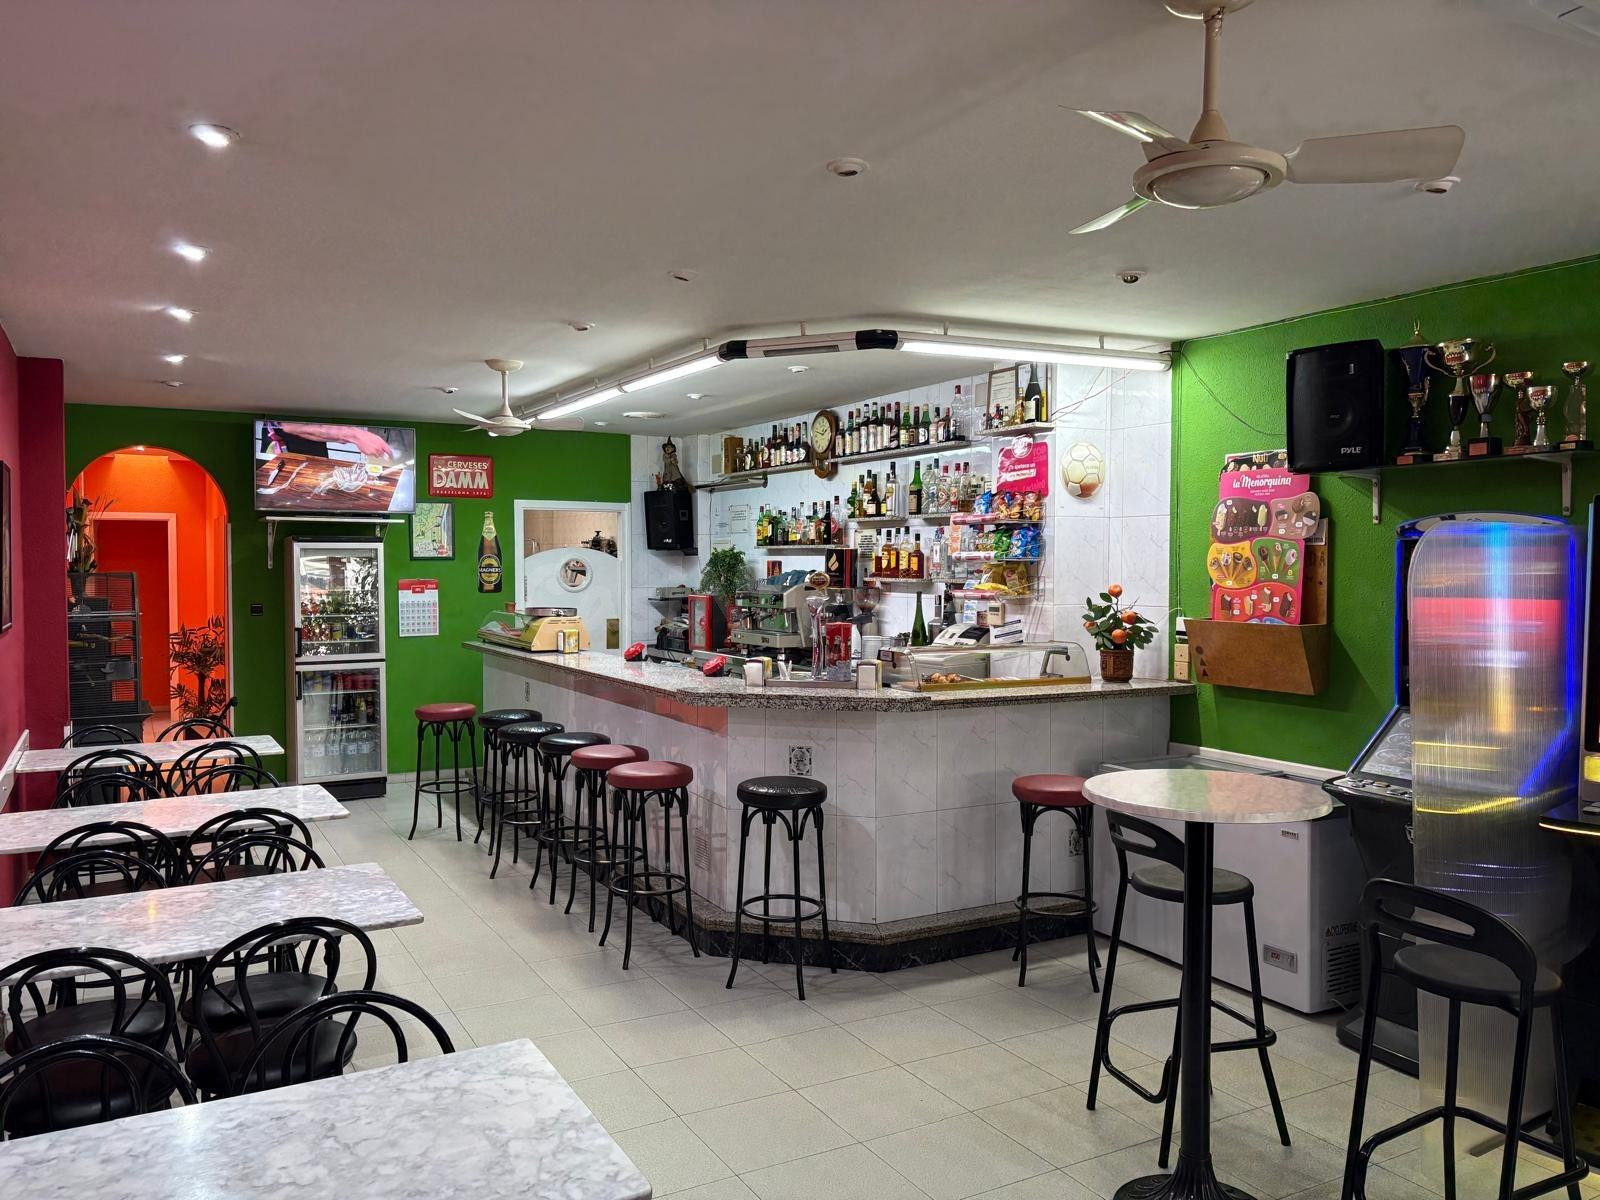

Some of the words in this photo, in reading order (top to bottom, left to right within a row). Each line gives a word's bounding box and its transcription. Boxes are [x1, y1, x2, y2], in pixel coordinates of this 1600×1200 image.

[447, 461, 488, 470] CERVESES
[433, 470, 489, 489] DAMM
[1241, 474, 1292, 490] Menorquina
